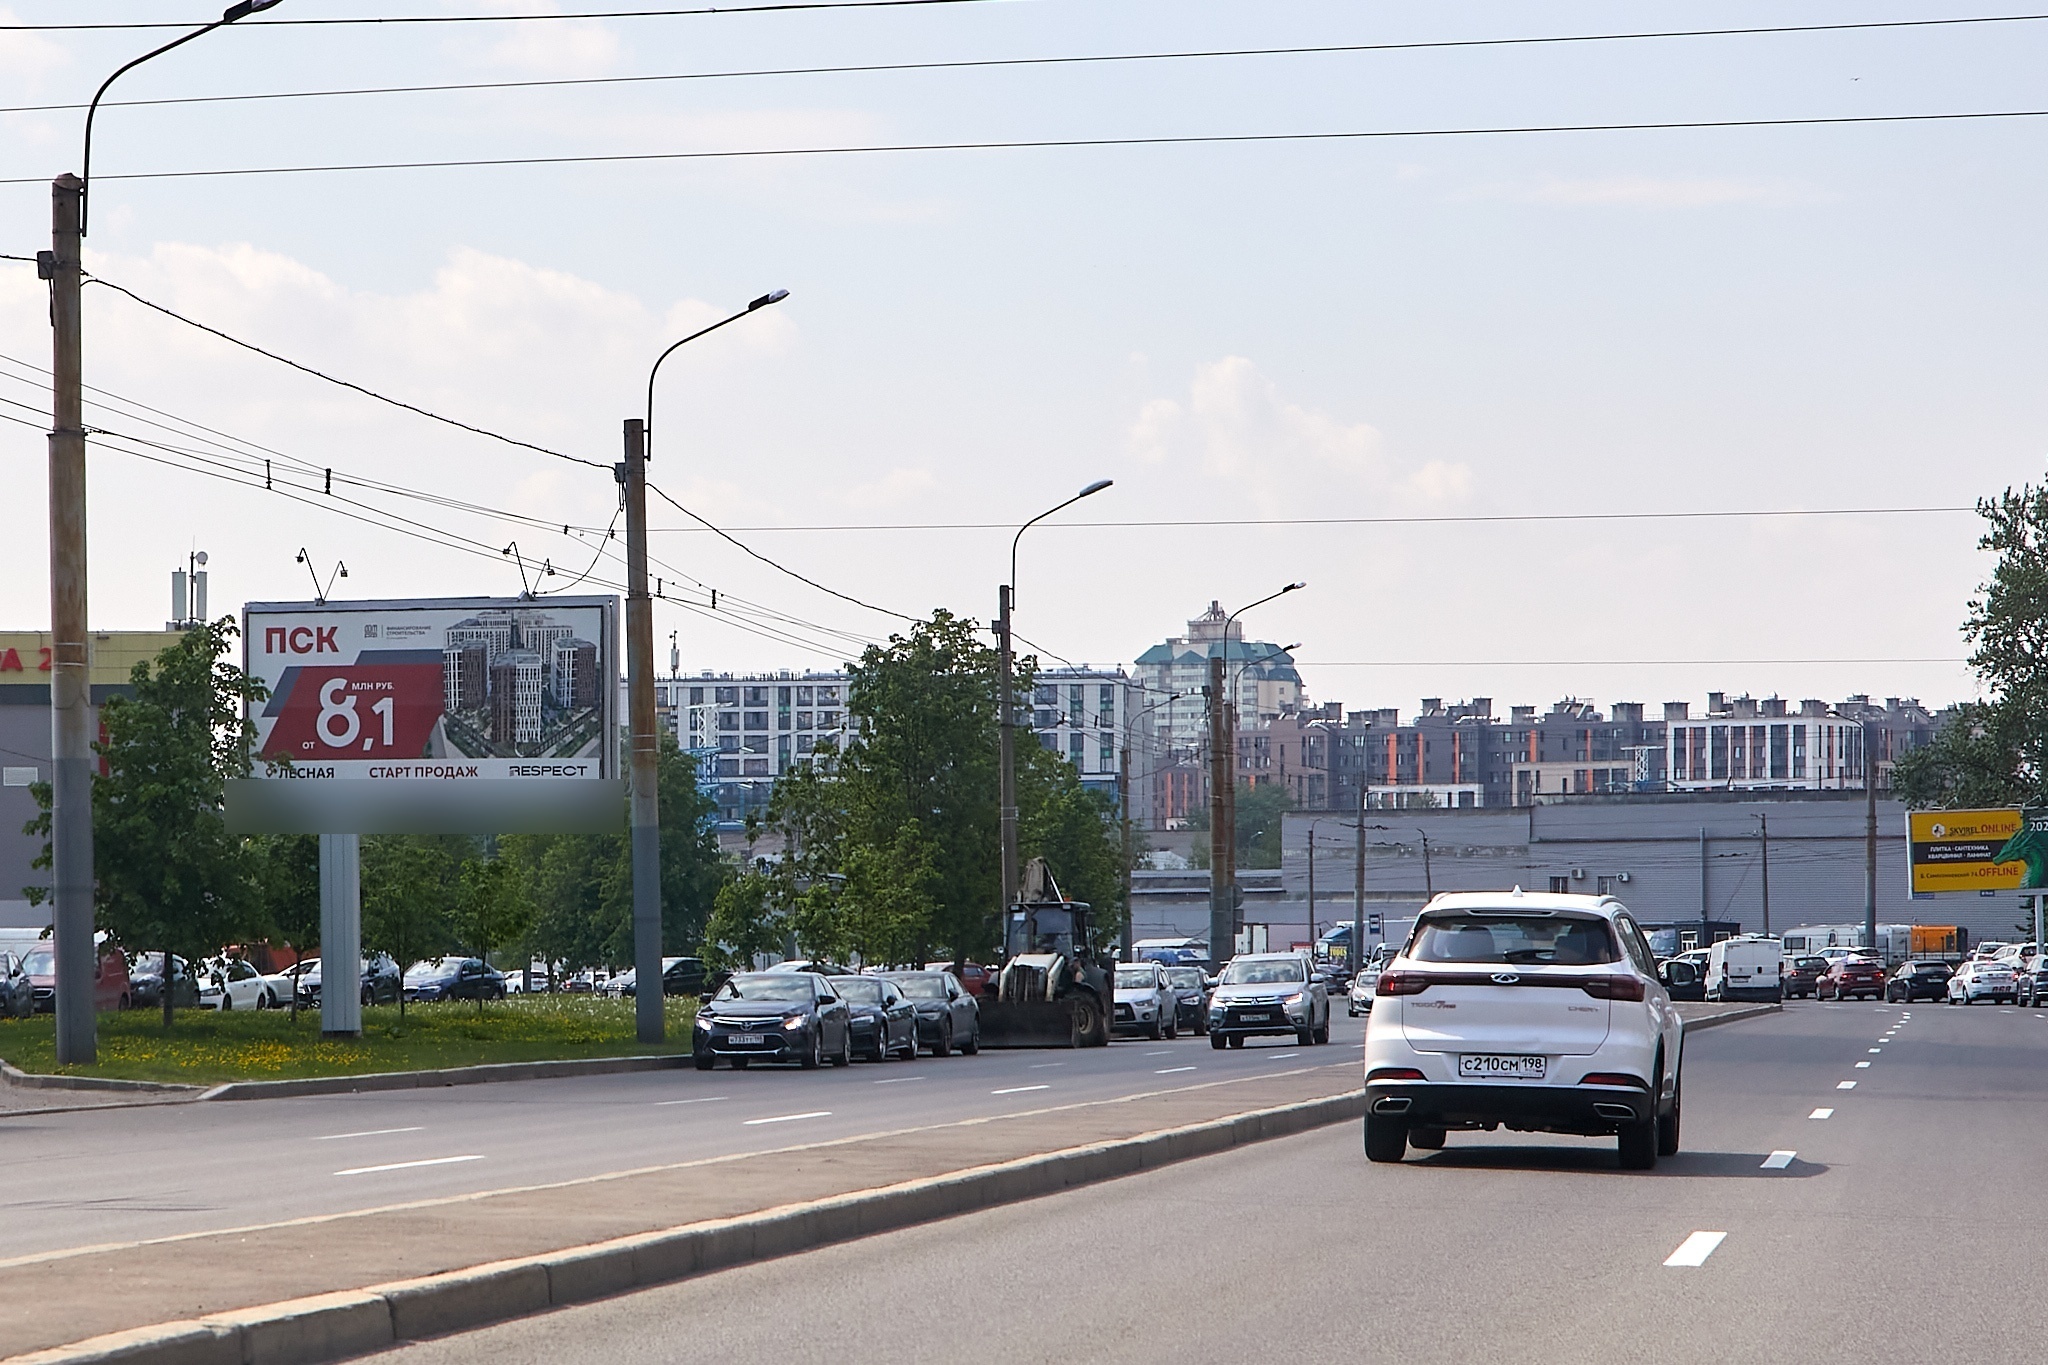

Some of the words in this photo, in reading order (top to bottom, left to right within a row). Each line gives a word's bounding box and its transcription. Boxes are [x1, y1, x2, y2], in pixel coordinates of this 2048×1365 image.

[265, 626, 339, 654] ПСК
[351, 682, 374, 691] МЛН
[375, 682, 395, 690] РУБ.
[316, 677, 393, 751] 8,1
[279, 767, 335, 779] ЛЕСНАЯ
[369, 766, 411, 778] СТАРТ
[414, 766, 478, 779] ПРОДАЖ
[509, 765, 588, 777] RESPECT
[1521, 1058, 1542, 1069] 198
